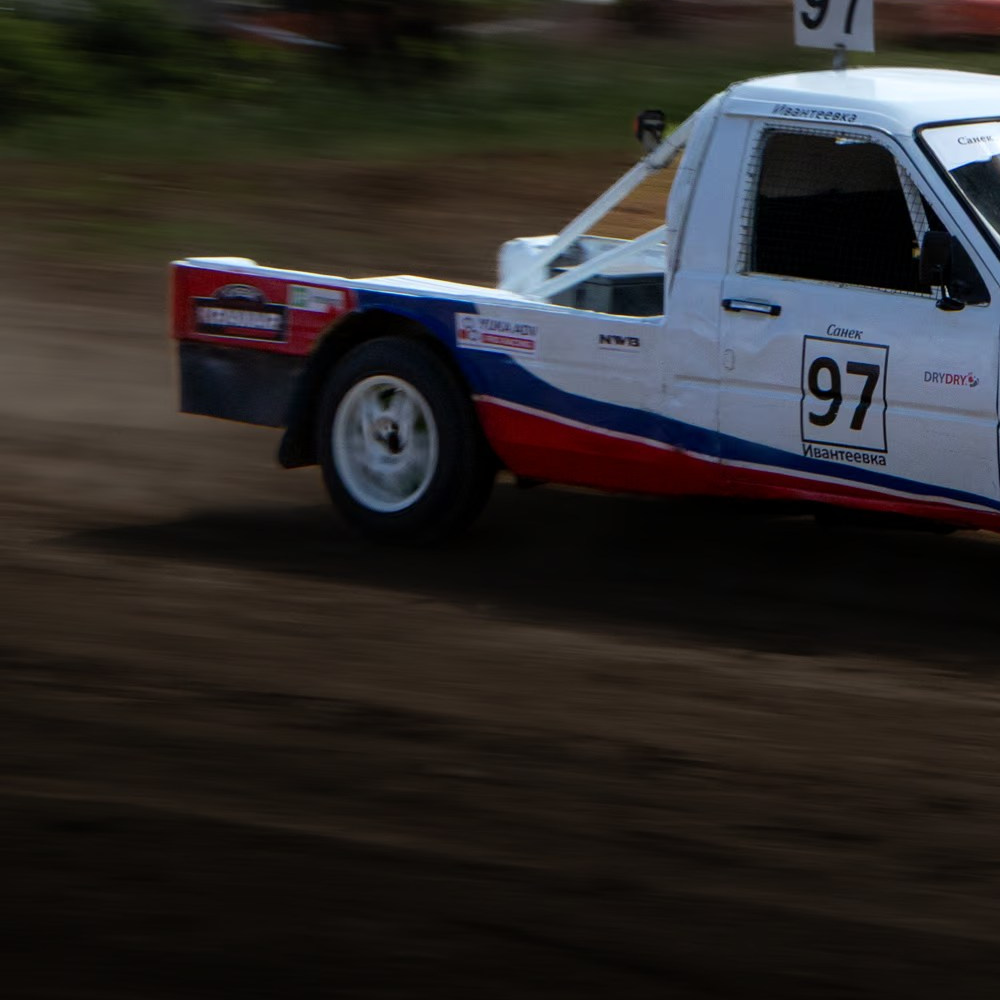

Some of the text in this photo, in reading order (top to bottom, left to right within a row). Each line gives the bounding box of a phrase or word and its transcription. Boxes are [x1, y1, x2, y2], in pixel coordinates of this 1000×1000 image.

[771, 104, 858, 123] Ивантеевка
[826, 323, 864, 340] Санек
[807, 355, 881, 431] 97
[802, 443, 887, 467] Ивантеевка
